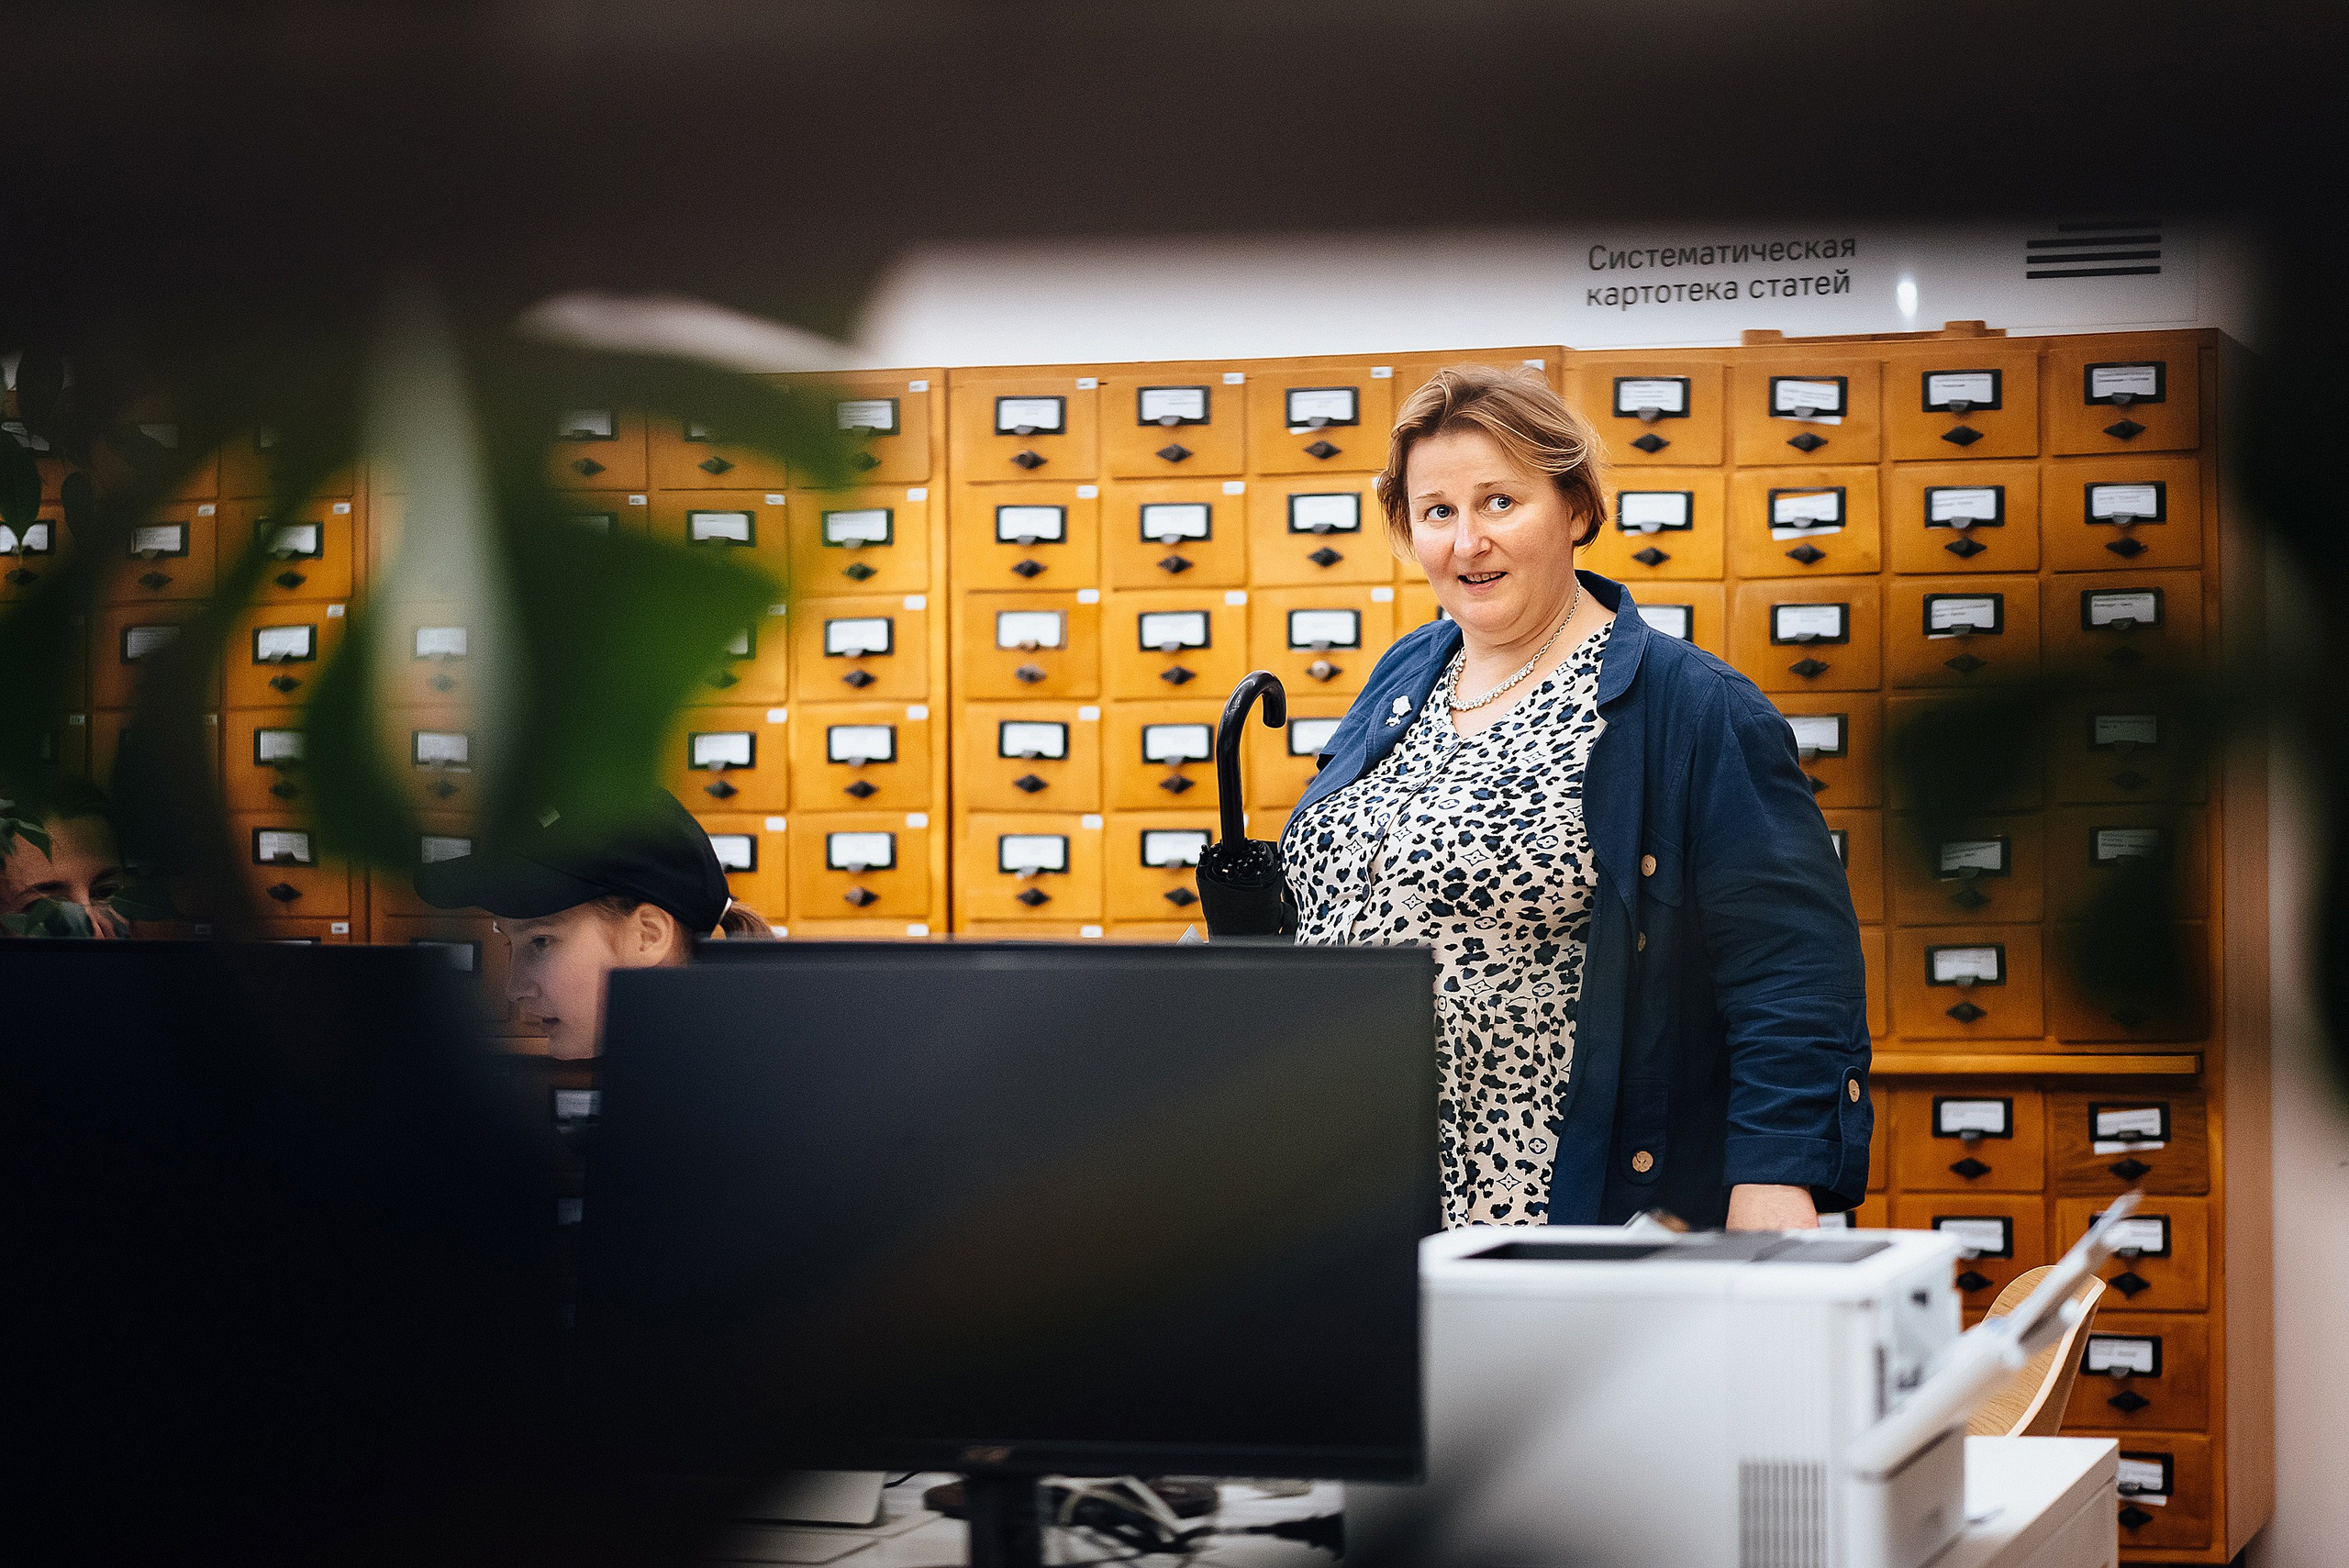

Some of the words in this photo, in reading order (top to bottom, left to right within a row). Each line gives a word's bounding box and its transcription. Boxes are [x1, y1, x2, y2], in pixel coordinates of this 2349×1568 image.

[1587, 238, 1856, 272] Систематическая
[1586, 280, 1739, 312] картотека
[1749, 268, 1851, 299] статей
